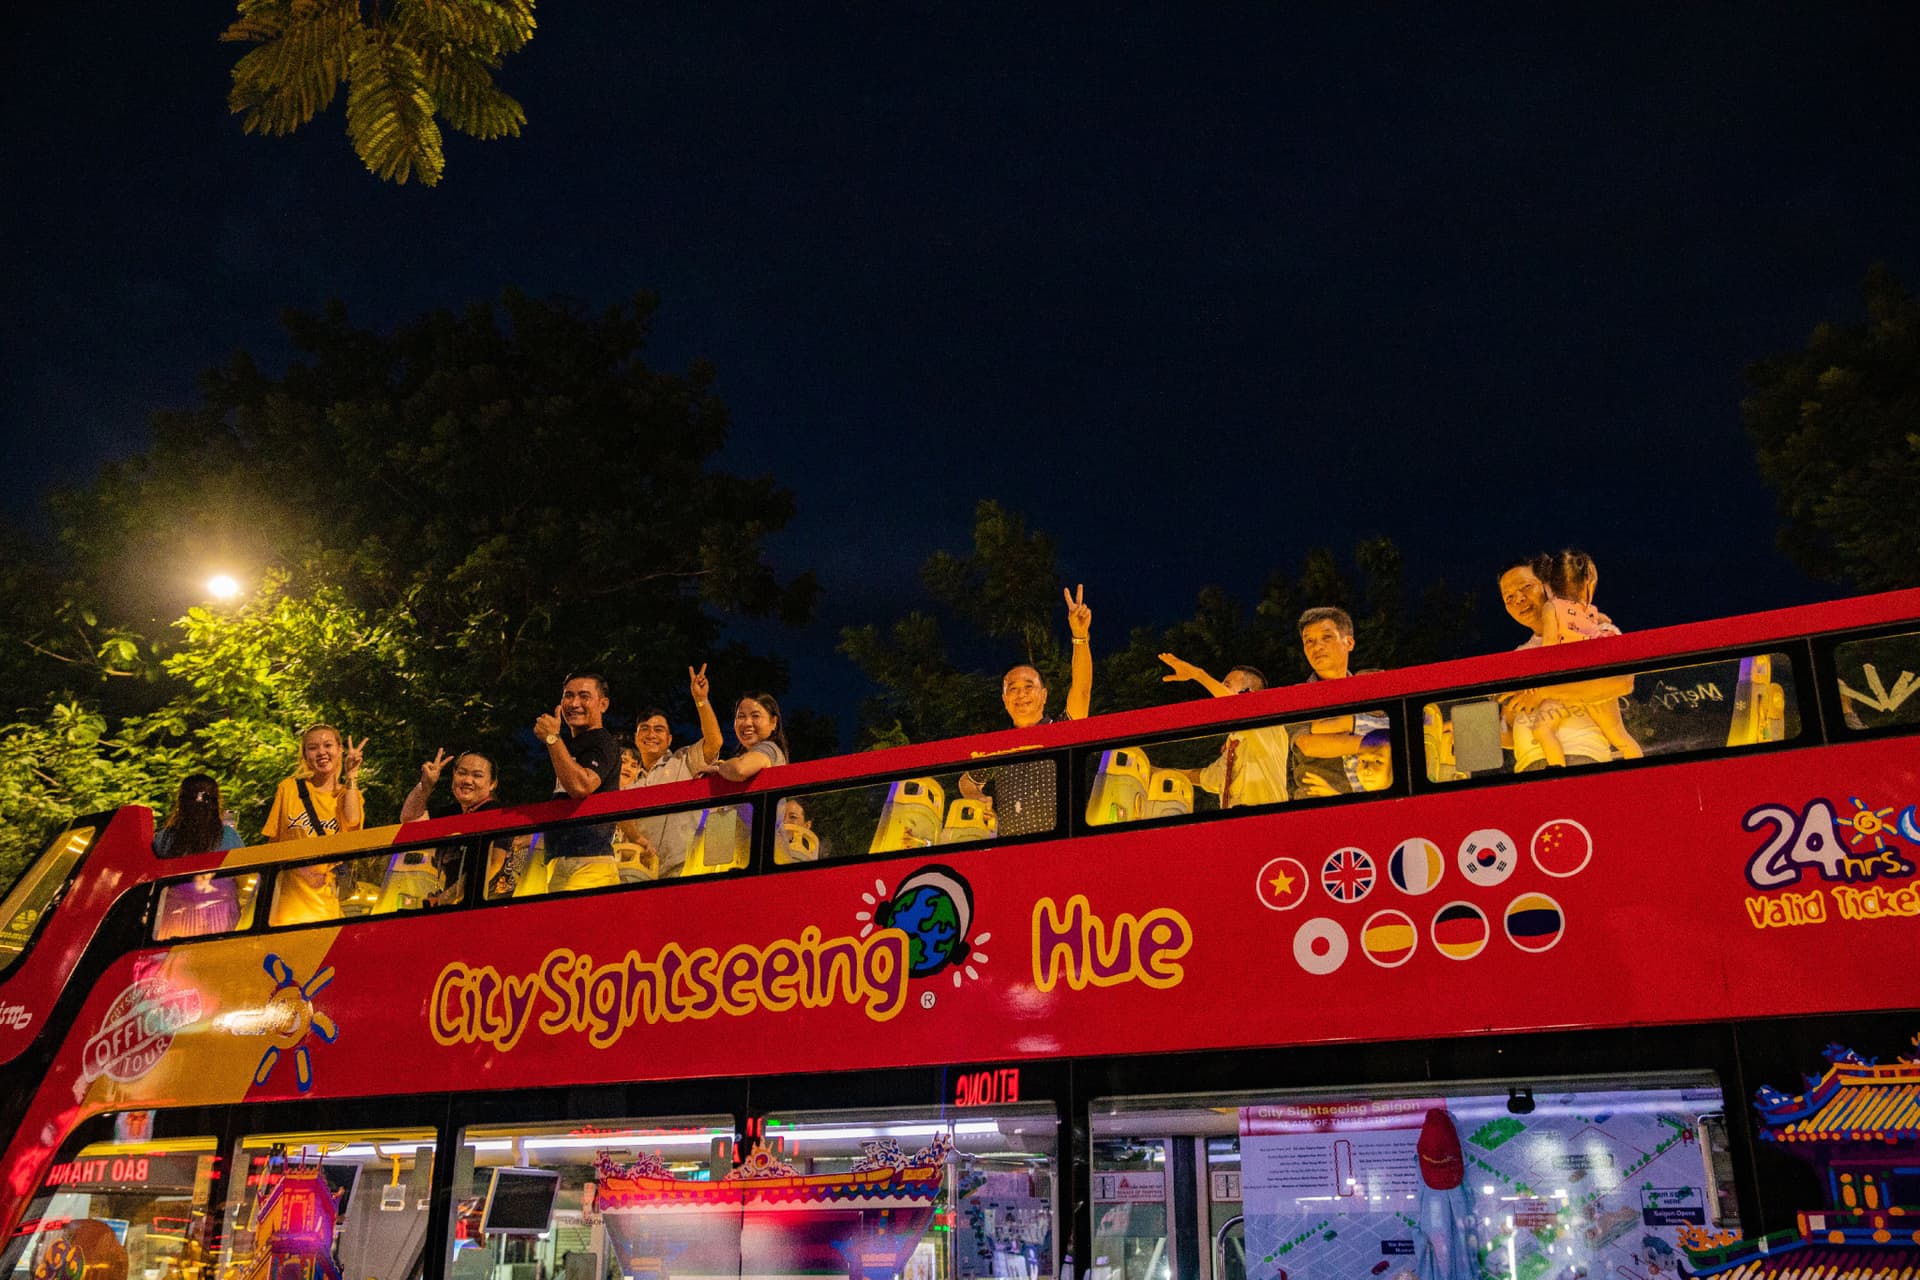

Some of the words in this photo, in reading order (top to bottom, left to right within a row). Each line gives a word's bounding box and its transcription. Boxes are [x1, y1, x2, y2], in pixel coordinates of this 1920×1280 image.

[1742, 798, 1852, 891] 24
[1745, 889, 1827, 929] Valid
[1032, 894, 1193, 992] Hue
[95, 994, 193, 1067] OFFICIAL
[121, 1037, 168, 1073] TOUR
[1258, 1107, 1283, 1119] City
[1287, 1103, 1368, 1119] Sightseeing
[1371, 1101, 1421, 1114] Saigon
